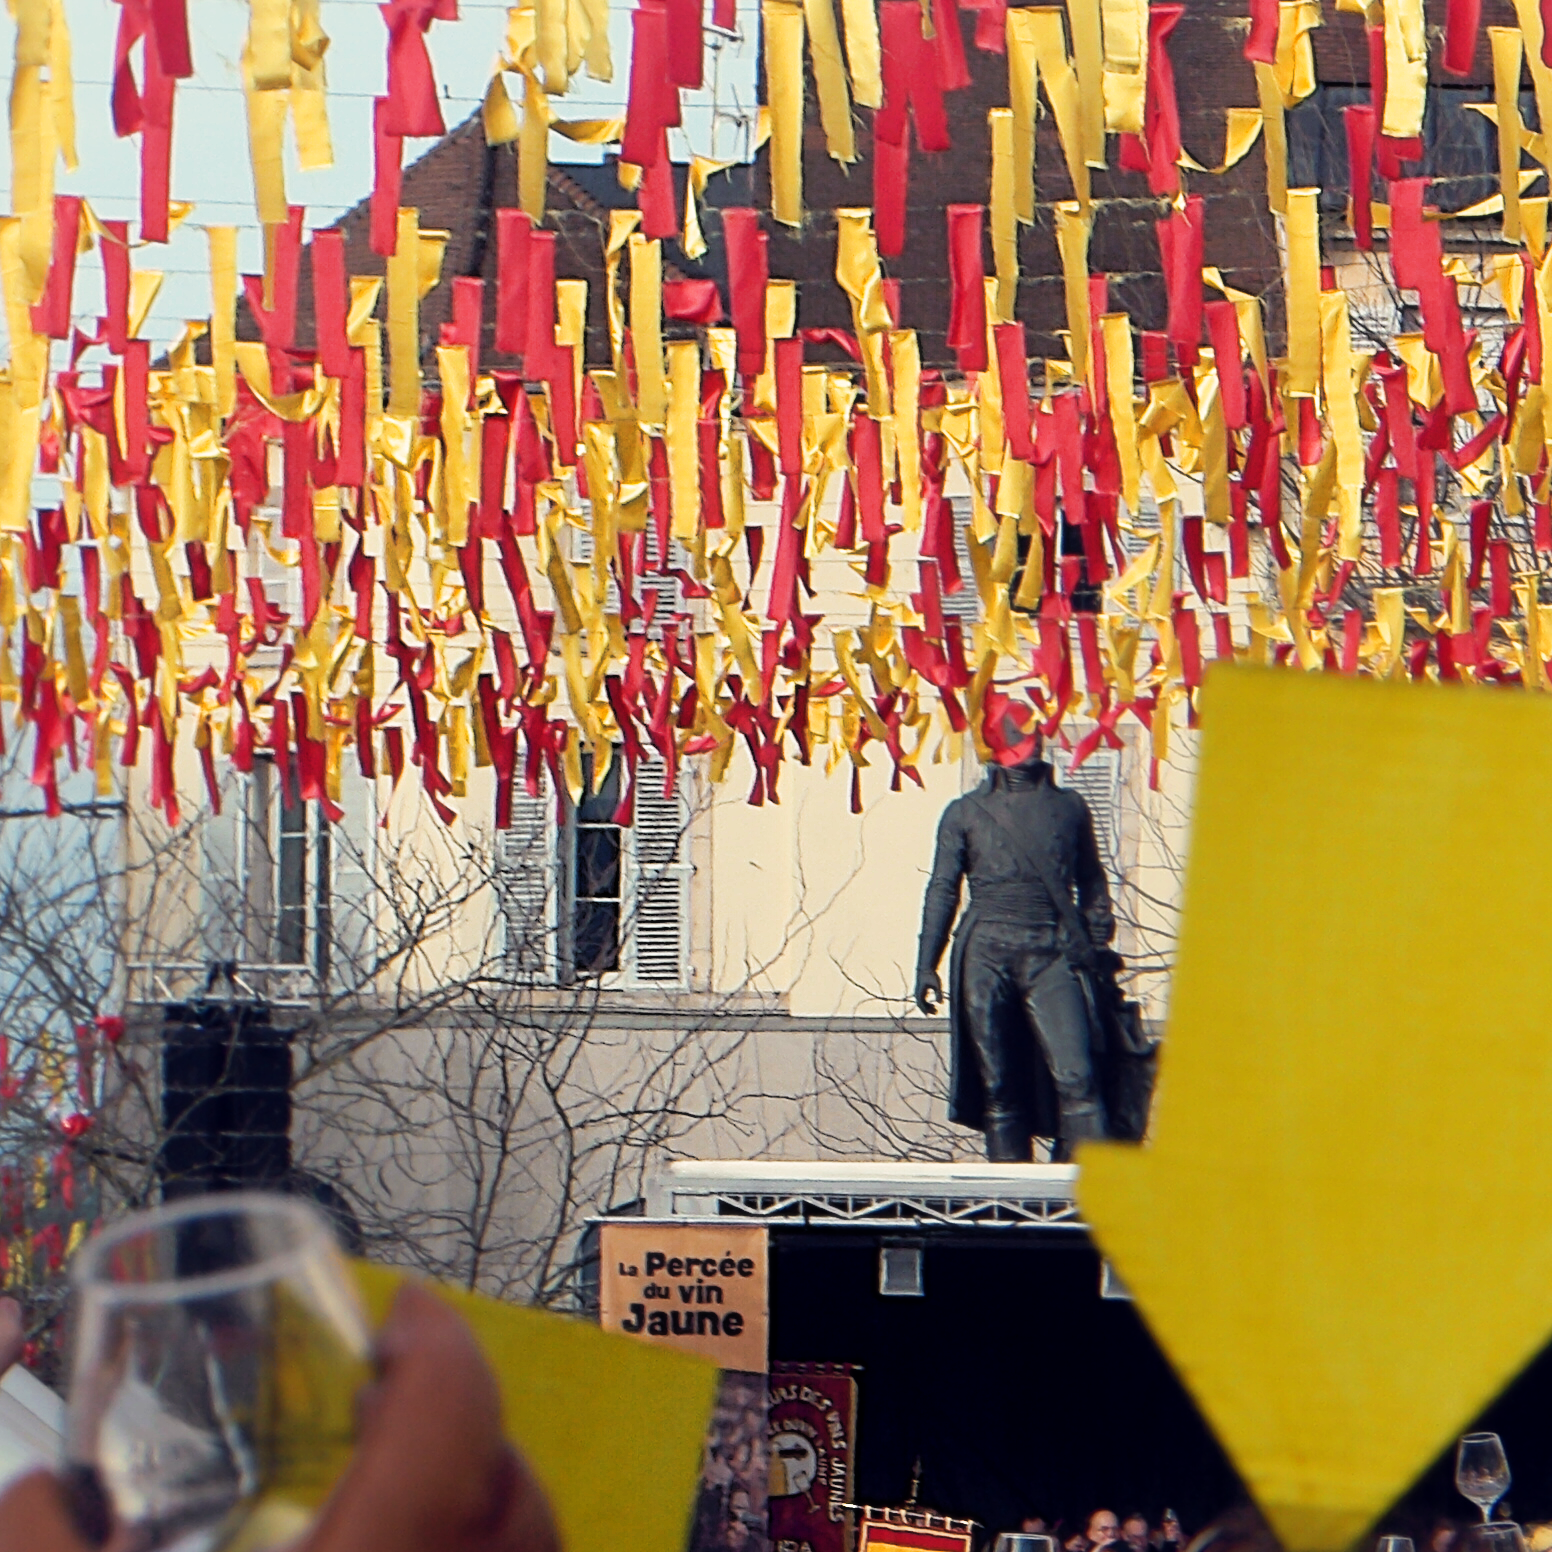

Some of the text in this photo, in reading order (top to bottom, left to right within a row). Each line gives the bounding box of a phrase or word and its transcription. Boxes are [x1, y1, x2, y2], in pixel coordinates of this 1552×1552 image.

[619, 1250, 755, 1277] La Percée
[643, 1278, 723, 1304] du vin
[622, 1303, 744, 1336] Jaune
[828, 1457, 847, 1522] JAUNES
